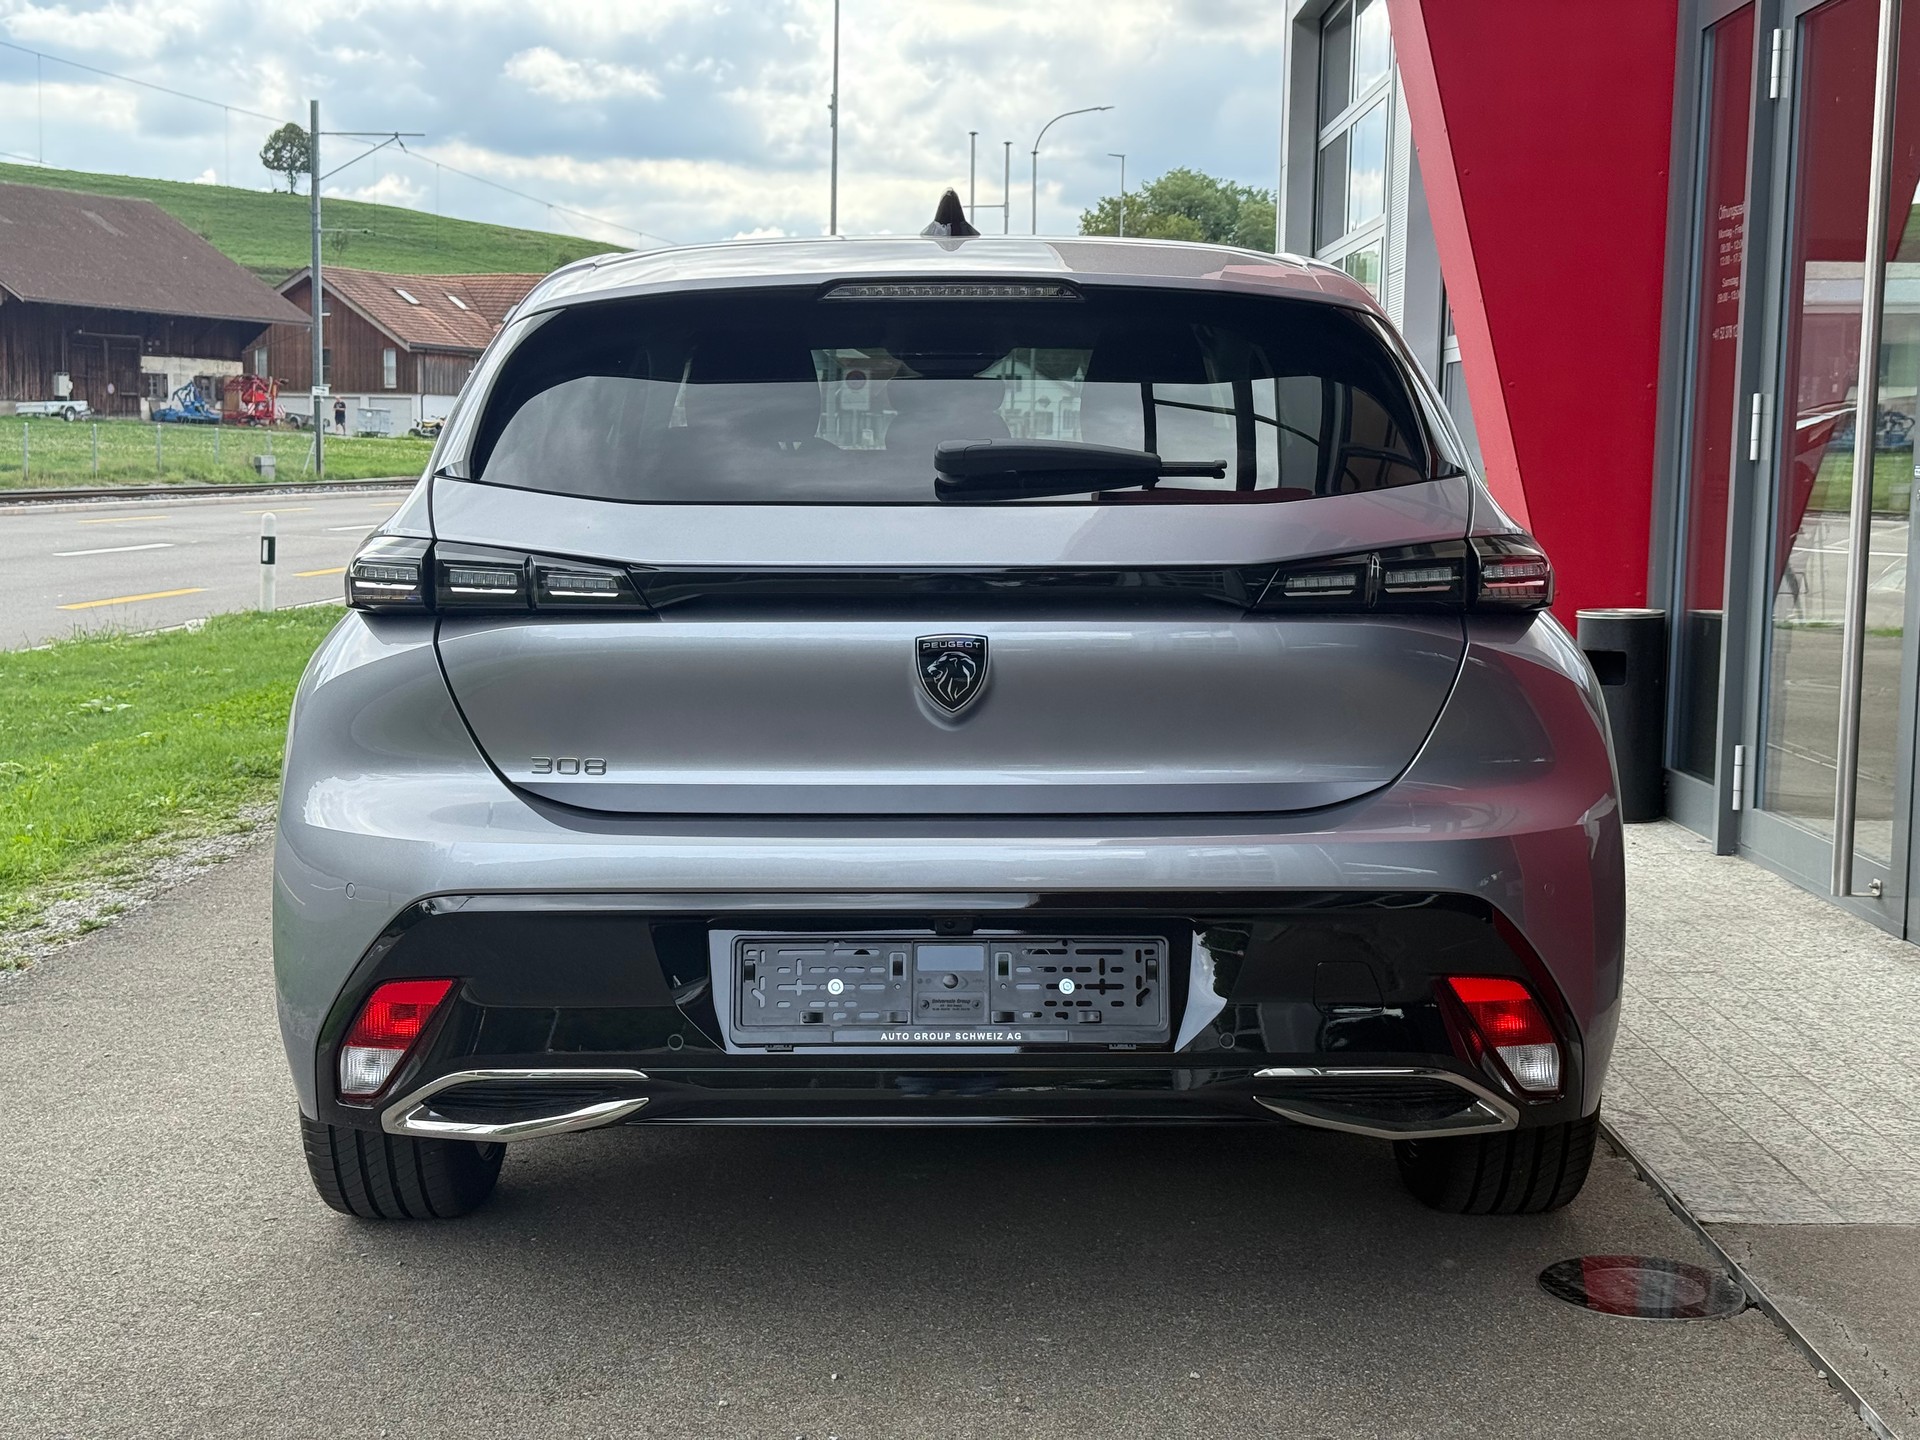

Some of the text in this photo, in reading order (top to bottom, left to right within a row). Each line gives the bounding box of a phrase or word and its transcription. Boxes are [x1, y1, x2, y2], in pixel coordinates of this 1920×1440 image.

[1718, 204, 1743, 220] Öffnungszei
[922, 641, 981, 650] PEUGEOT
[530, 756, 607, 776] 308
[880, 1032, 1022, 1041] AUTO GROUP SCHWEIZ AG
